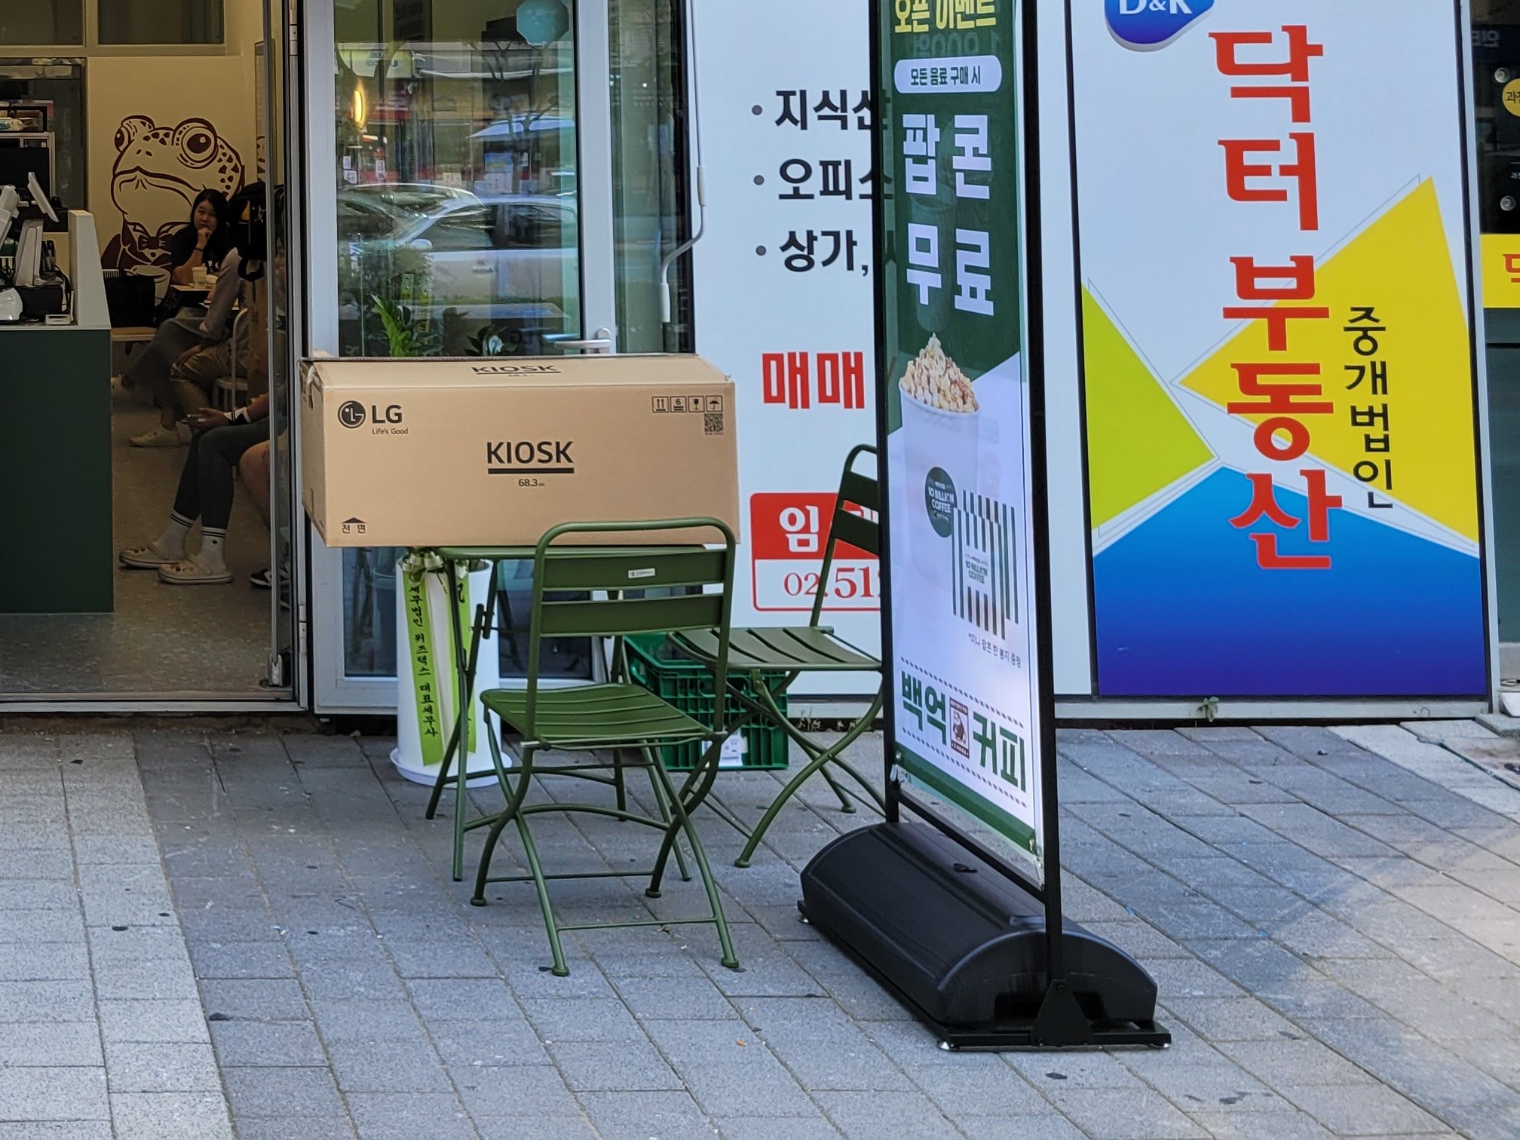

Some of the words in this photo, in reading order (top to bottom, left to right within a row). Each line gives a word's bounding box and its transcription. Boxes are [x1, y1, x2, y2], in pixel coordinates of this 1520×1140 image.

[911, 67, 928, 86] 모든
[930, 67, 948, 85] 음료
[951, 65, 968, 85] 구매
[971, 65, 981, 84] 시
[902, 113, 992, 200] 팝콘
[906, 223, 994, 316] 무료
[1208, 25, 1344, 570] 닥터부동산
[471, 364, 558, 374] KIOSK
[762, 351, 865, 409] 매매
[371, 404, 403, 424] LG
[372, 427, 389, 436] Life's
[390, 427, 409, 436] Good
[1343, 306, 1394, 510] 중개법인
[486, 440, 575, 464] KIOSK
[901, 670, 947, 747] 백억
[972, 711, 1027, 793] 커피
